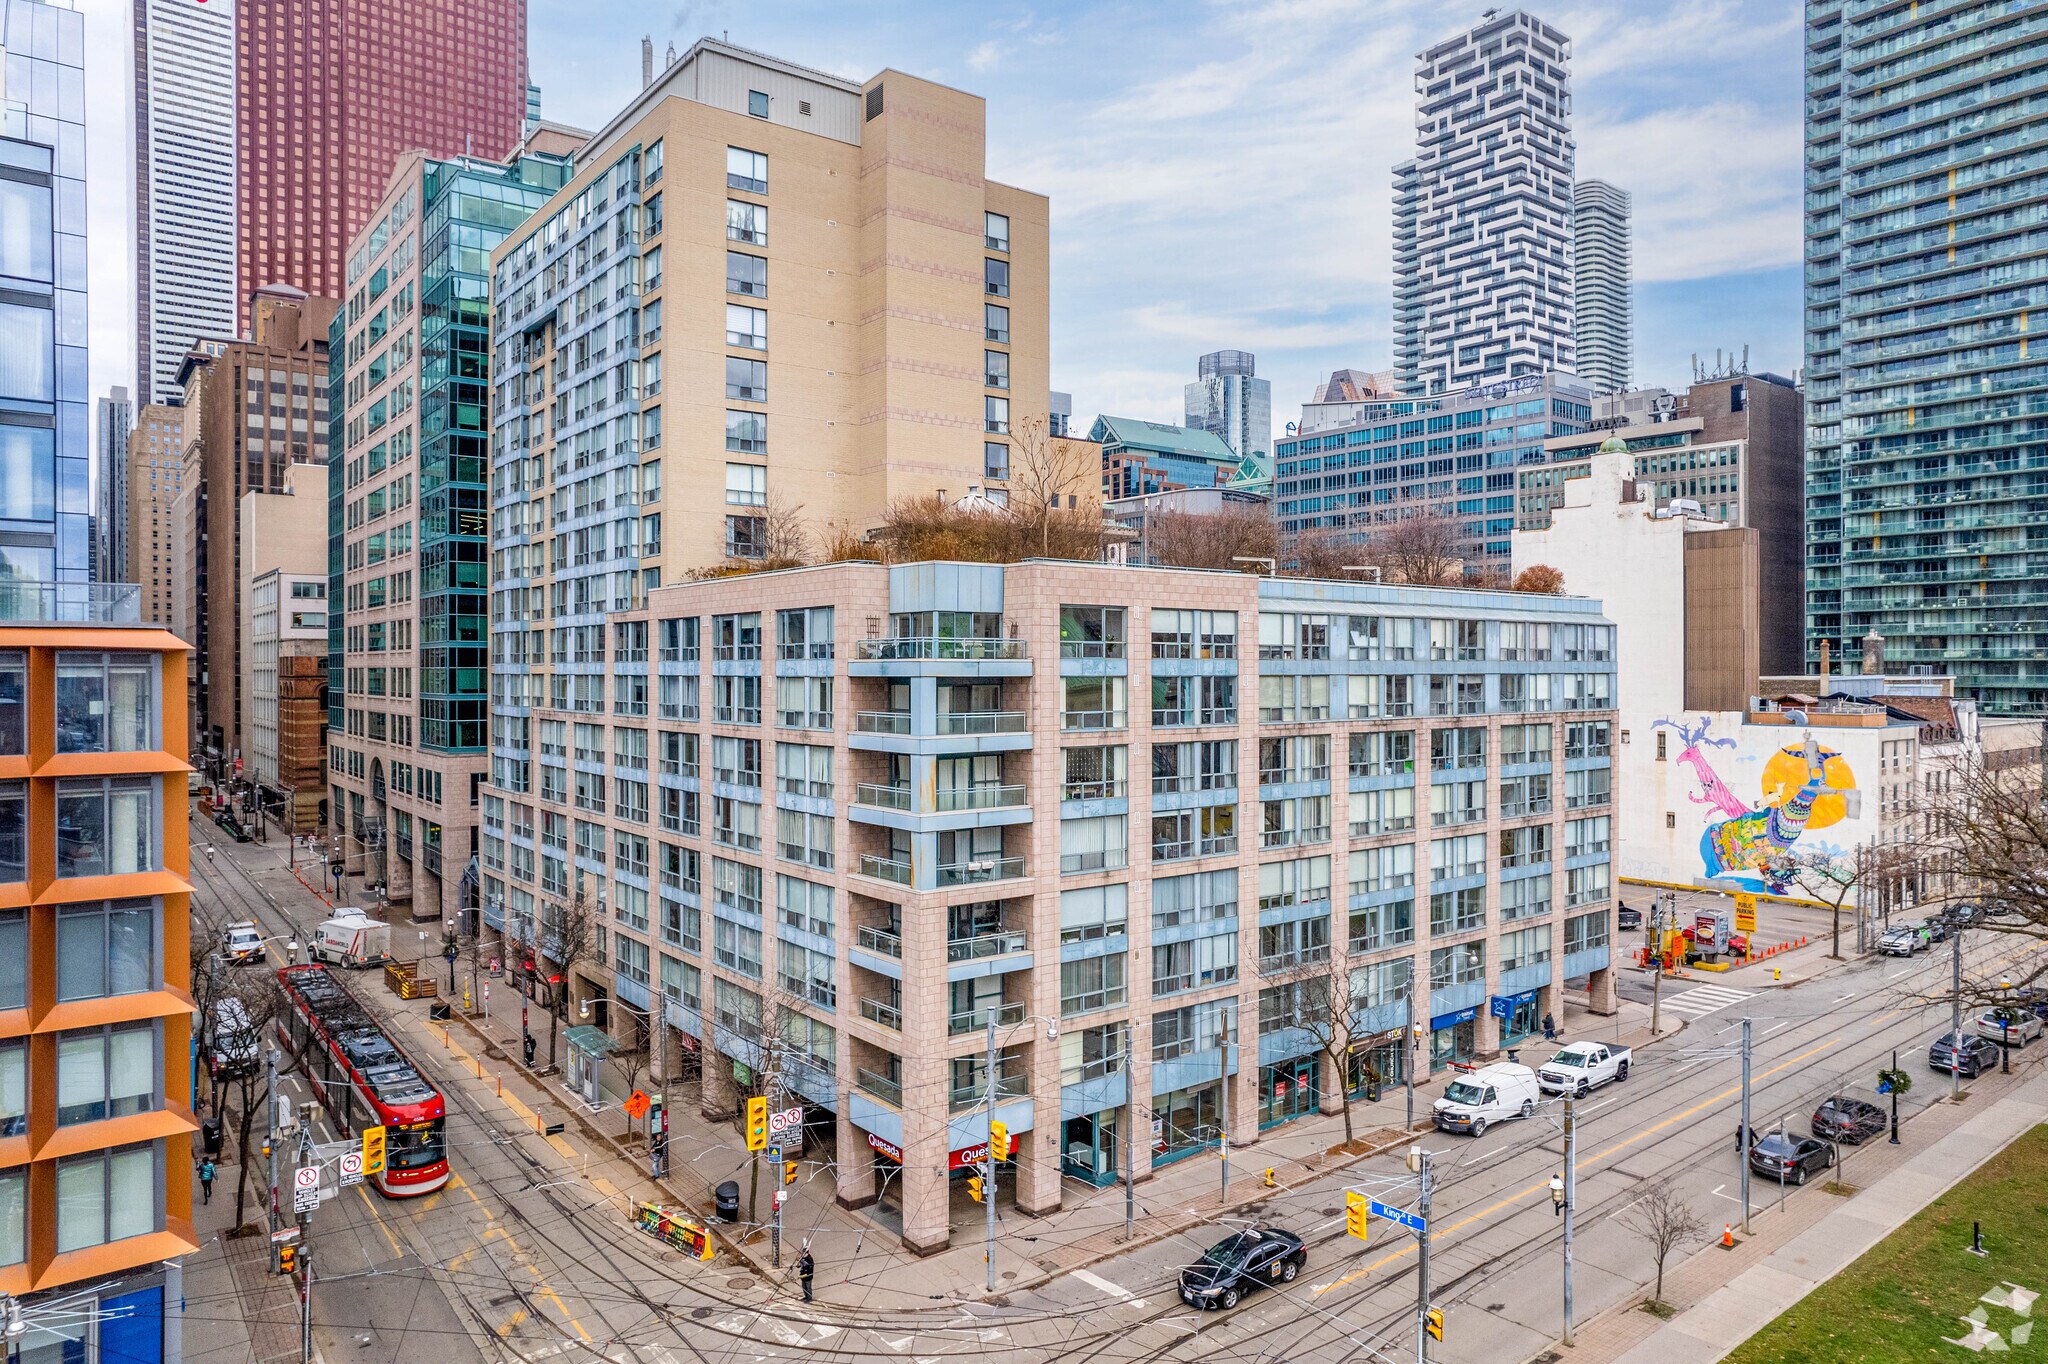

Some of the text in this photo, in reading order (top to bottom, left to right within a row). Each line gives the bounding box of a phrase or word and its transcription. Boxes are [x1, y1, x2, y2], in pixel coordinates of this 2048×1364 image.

[868, 1133, 900, 1158] Quesada
[961, 1147, 989, 1163] Ques
[1383, 1206, 1400, 1221] King
[1407, 1215, 1413, 1225] E
